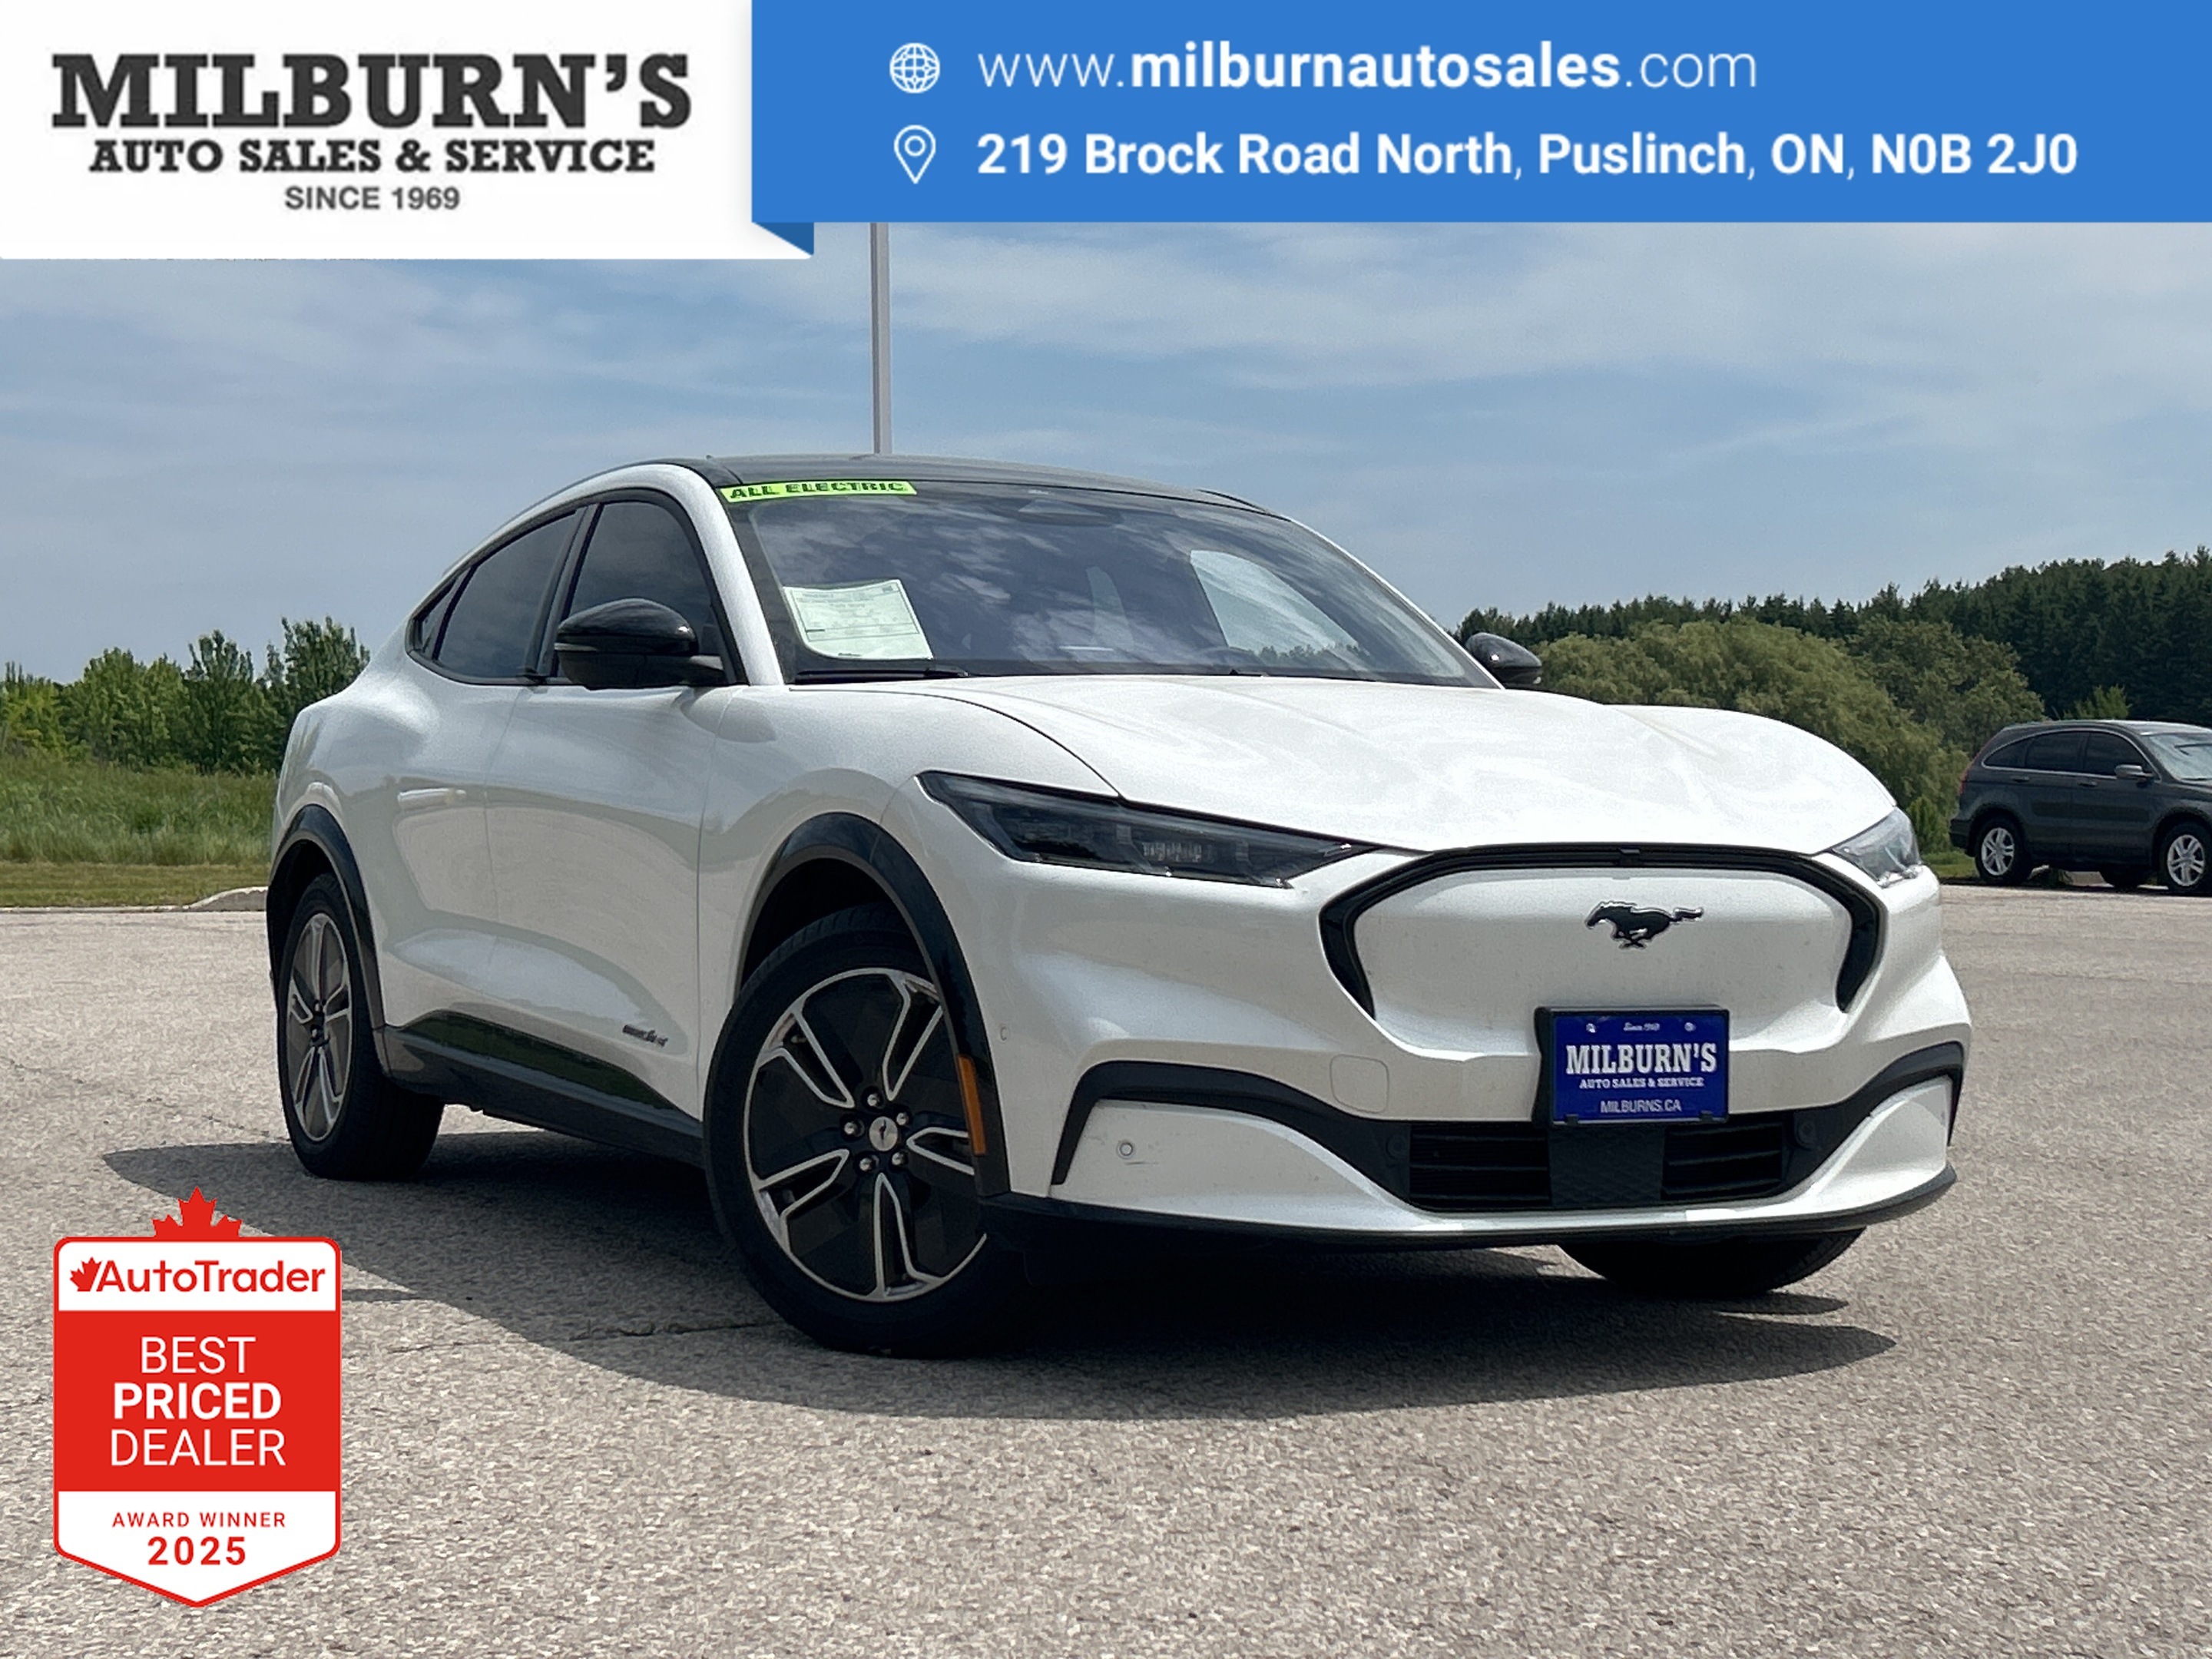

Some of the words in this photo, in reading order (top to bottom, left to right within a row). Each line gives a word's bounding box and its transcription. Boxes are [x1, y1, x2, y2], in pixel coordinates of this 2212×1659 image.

[730, 486, 779, 498] ALL
[786, 482, 908, 492] ELECTRIC
[1566, 1043, 1717, 1074] MILBURN'S
[1579, 1078, 1611, 1089] AUTO
[1613, 1078, 1646, 1088] SALES
[1647, 1077, 1655, 1088] &
[1657, 1077, 1704, 1088] SERVICE
[1601, 1099, 1682, 1113] MILBURNS.CA
